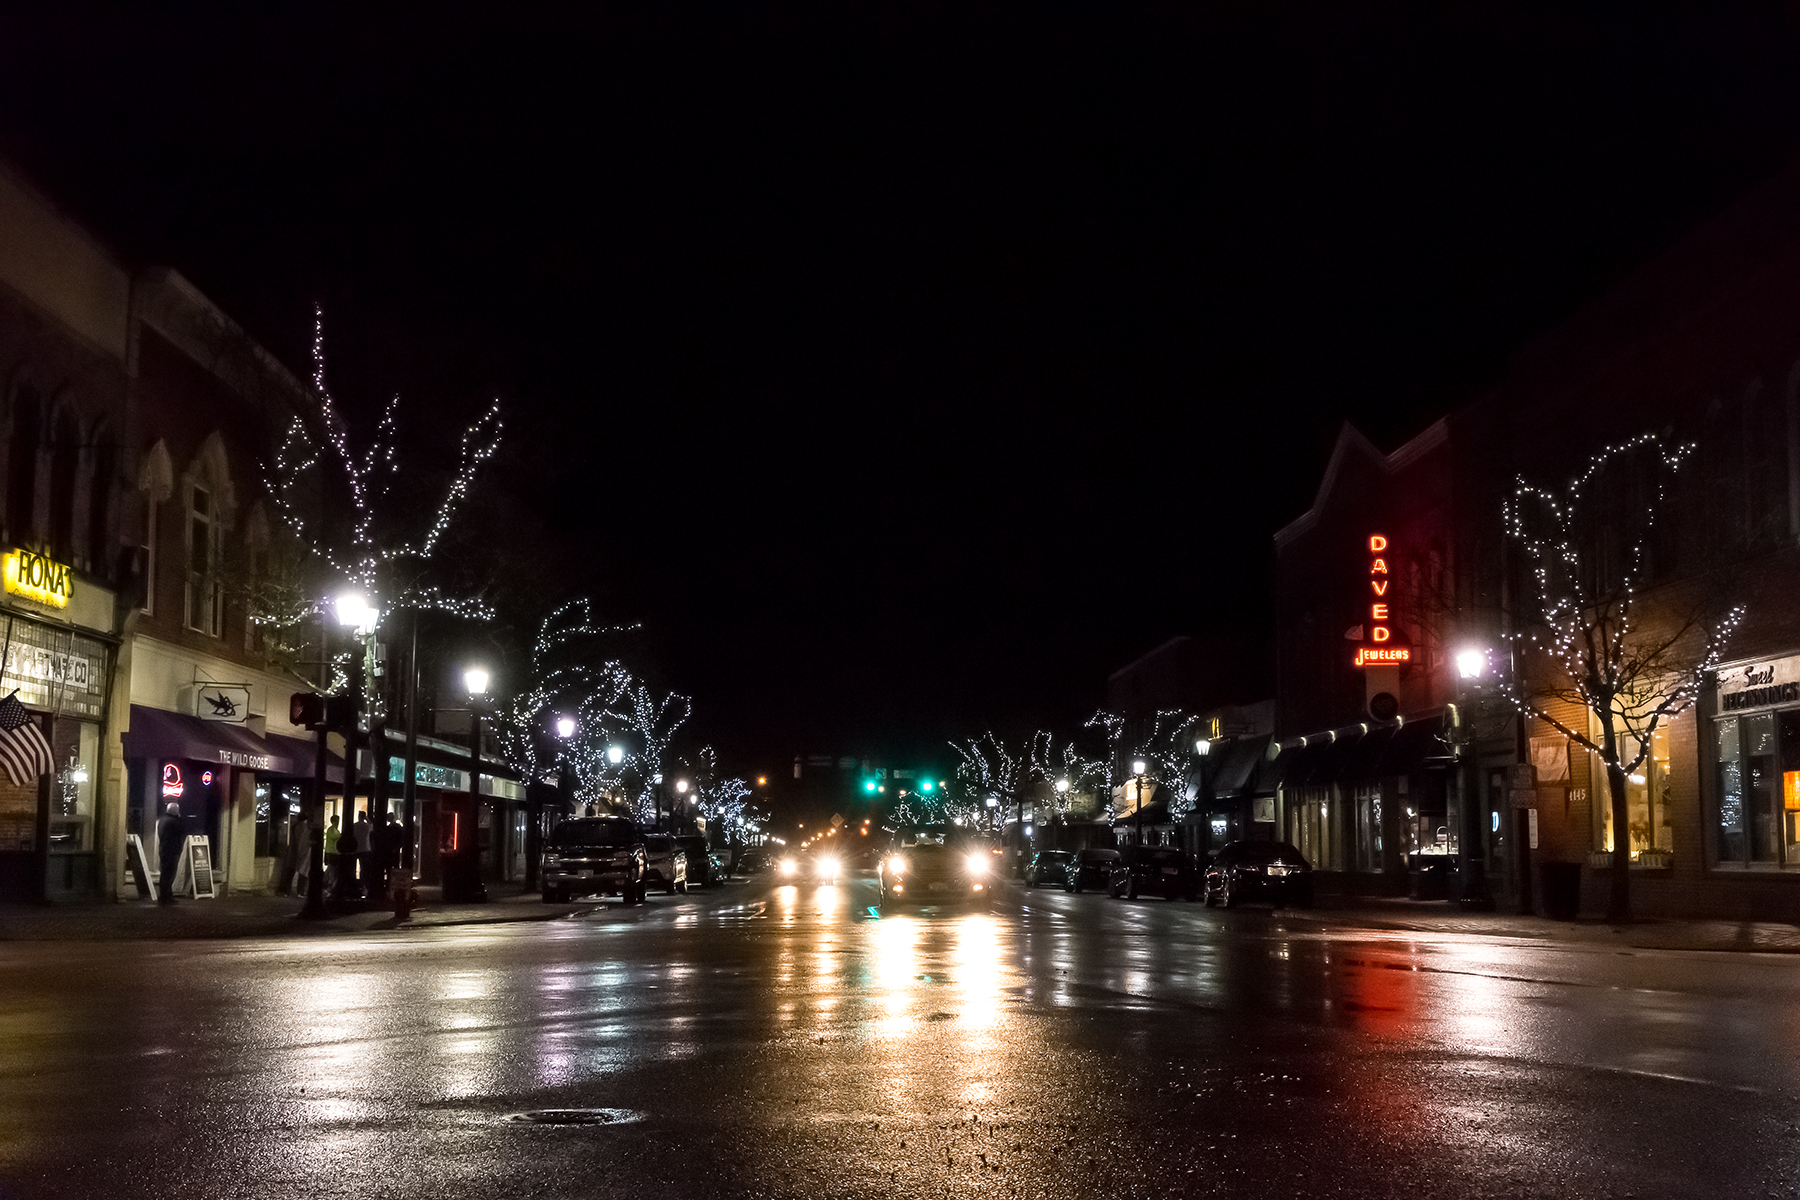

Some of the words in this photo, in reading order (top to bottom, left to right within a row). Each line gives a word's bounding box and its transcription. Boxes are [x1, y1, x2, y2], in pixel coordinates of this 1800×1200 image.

[18, 551, 74, 598] FIONA'S
[1370, 535, 1390, 642] DAVED
[1355, 648, 1410, 666] JEWELERS
[1723, 681, 1799, 711] BEGINNINGS
[219, 750, 231, 764] THE
[232, 752, 248, 766] WILD
[249, 755, 269, 769] GOOSE
